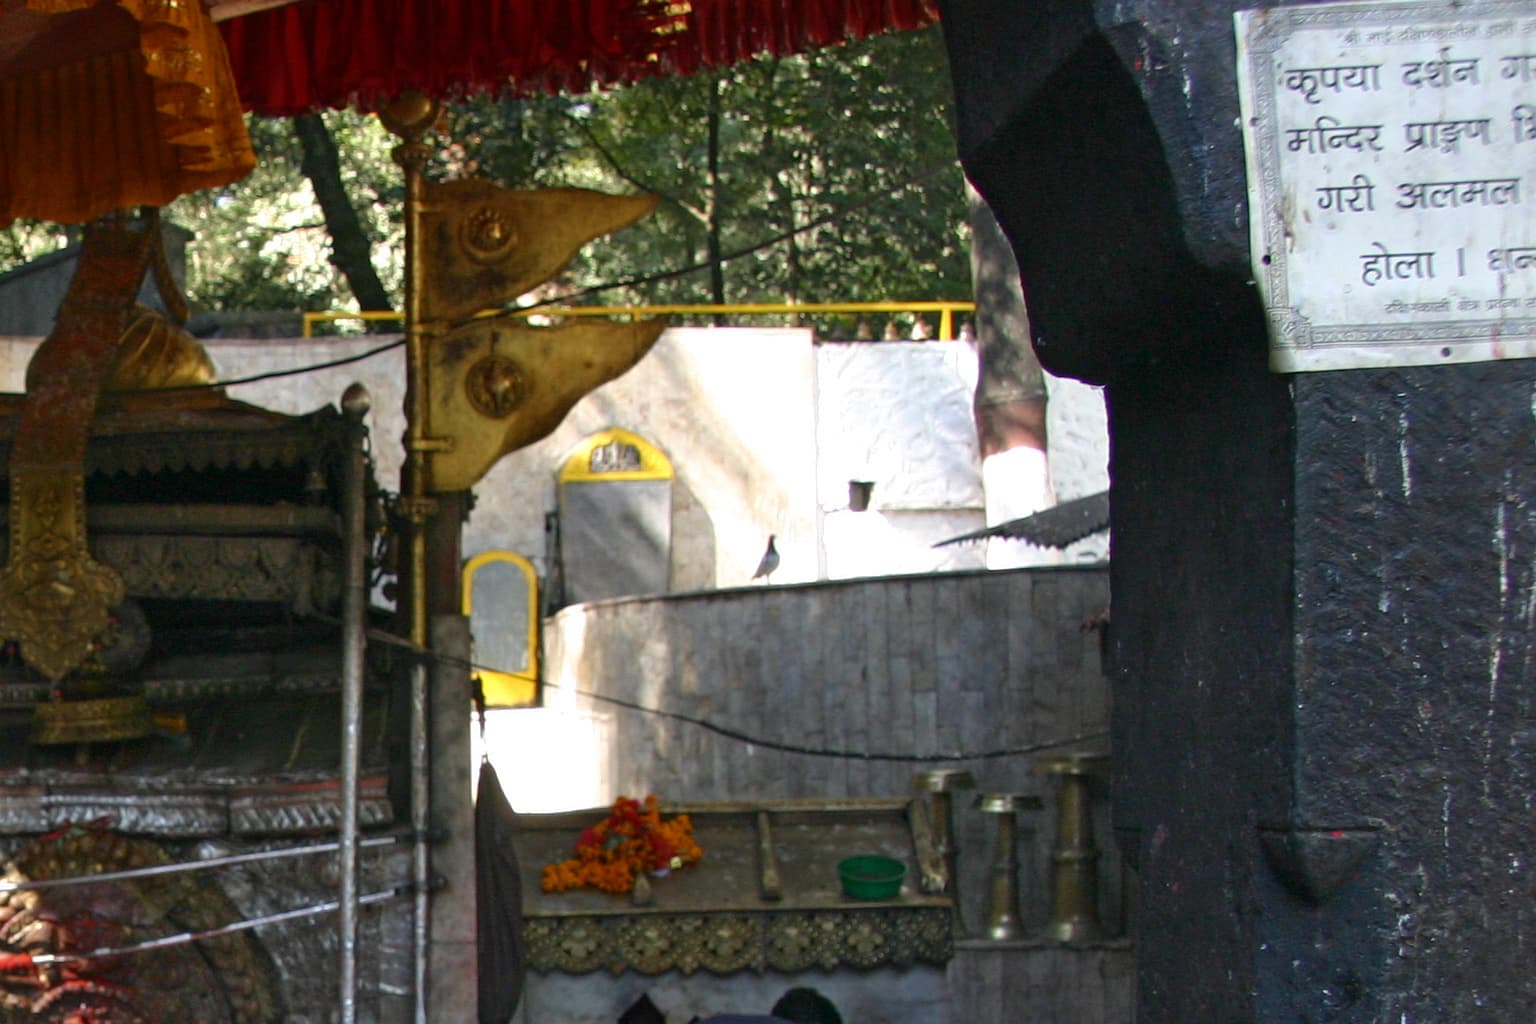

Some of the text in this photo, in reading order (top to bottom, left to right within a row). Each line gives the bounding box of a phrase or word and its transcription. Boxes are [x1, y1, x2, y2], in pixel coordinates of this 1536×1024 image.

[1284, 63, 1384, 104] कृपया
[1401, 46, 1480, 88] दर्शन
[1286, 115, 1385, 153] मन्दिर
[1316, 174, 1521, 212] गरी अलमल
[1360, 241, 1436, 287] होला
